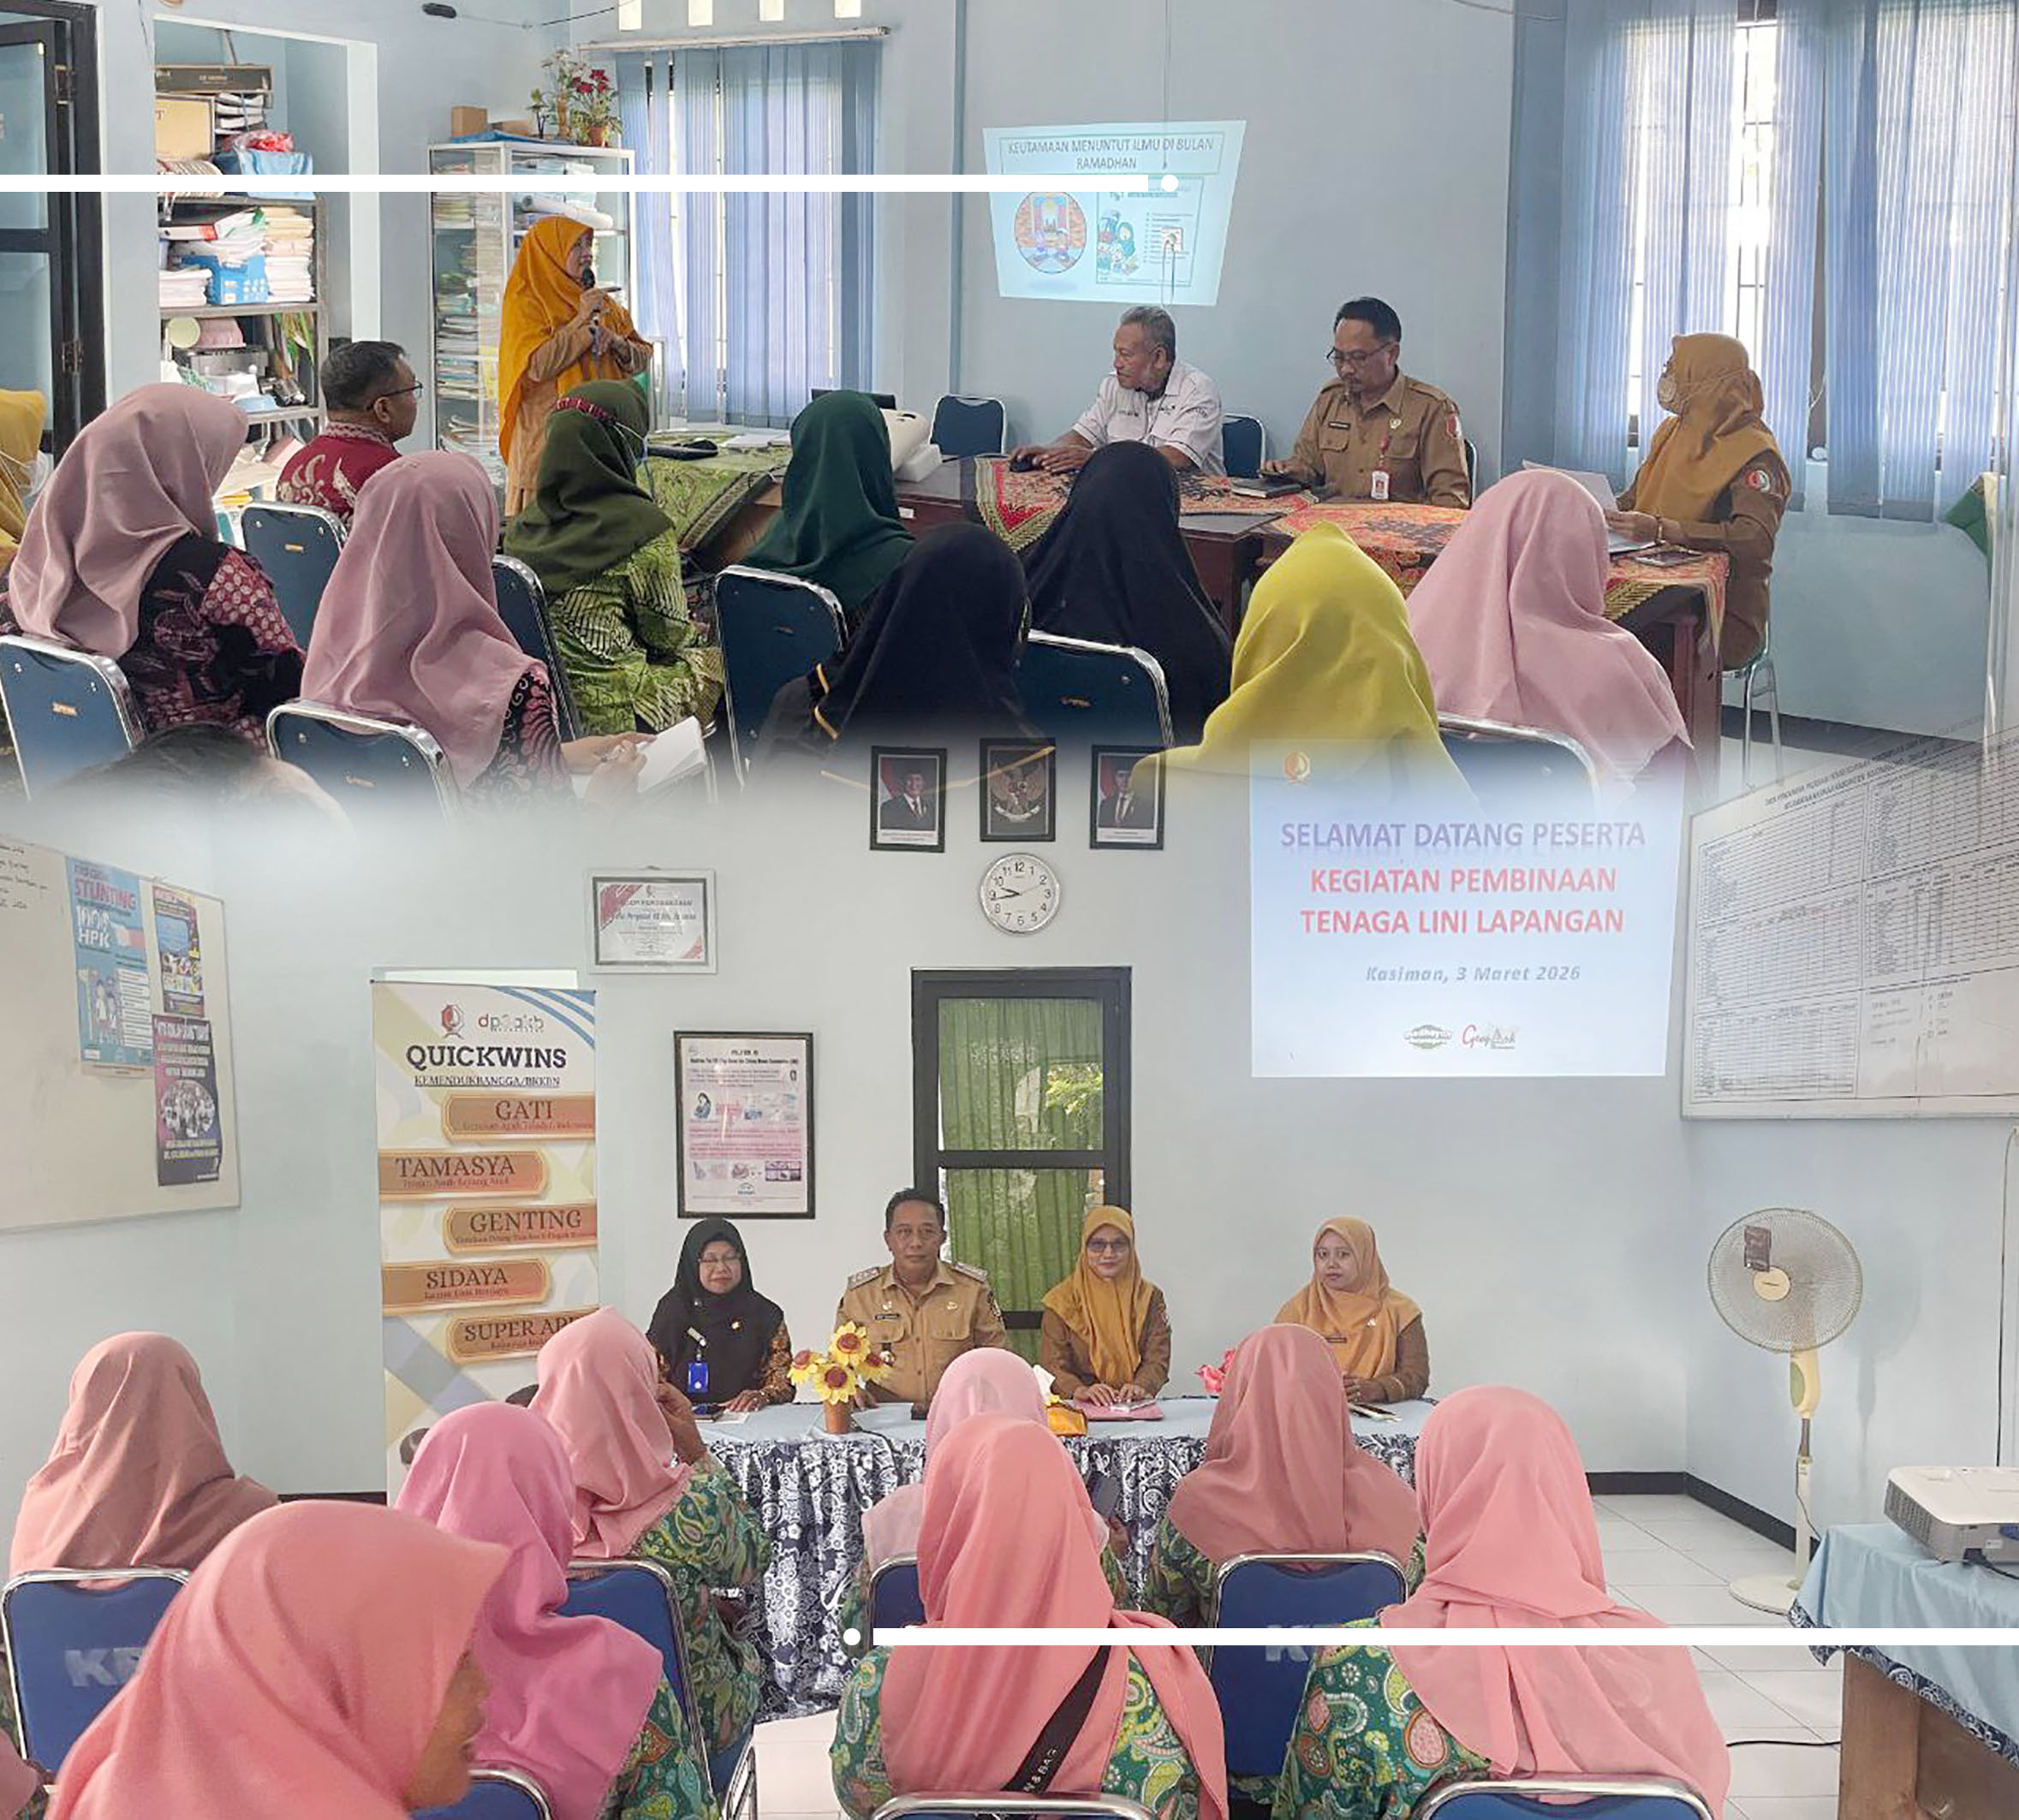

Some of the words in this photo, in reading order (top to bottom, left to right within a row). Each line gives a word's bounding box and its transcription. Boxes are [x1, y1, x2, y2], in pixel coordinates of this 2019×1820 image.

[1008, 140, 1069, 154] KEUTAMAAN
[1072, 139, 1130, 152] MENUNTUT
[1133, 138, 1160, 151] ILMU
[1163, 138, 1176, 151] DI
[1177, 138, 1213, 150] BULAN
[1076, 158, 1137, 170] RAMADHAN
[1280, 823, 1406, 848] SELAMAT
[1414, 823, 1523, 847] DATANG
[1533, 822, 1646, 846] PESERTA
[1015, 862, 1025, 872] 12
[1310, 869, 1440, 892] KEGIATAN
[1450, 868, 1617, 891] PEMBINAAN
[1301, 911, 1410, 934] TENAGA
[1419, 911, 1468, 933] LINI
[1477, 910, 1624, 933] LAPANGAN
[79, 927, 110, 948] HPK
[1366, 966, 1450, 984] Kasiman,
[1456, 967, 1467, 981] 3
[1474, 967, 1529, 981] Maret
[1536, 966, 1581, 981] 2026
[406, 1044, 567, 1071] QUICKWINS
[495, 1100, 554, 1121] GATI
[396, 1156, 515, 1178] TAMASYA
[470, 1210, 582, 1233] GENTING
[427, 1268, 508, 1288] SIDAYA
[465, 1320, 535, 1341] SUPER
